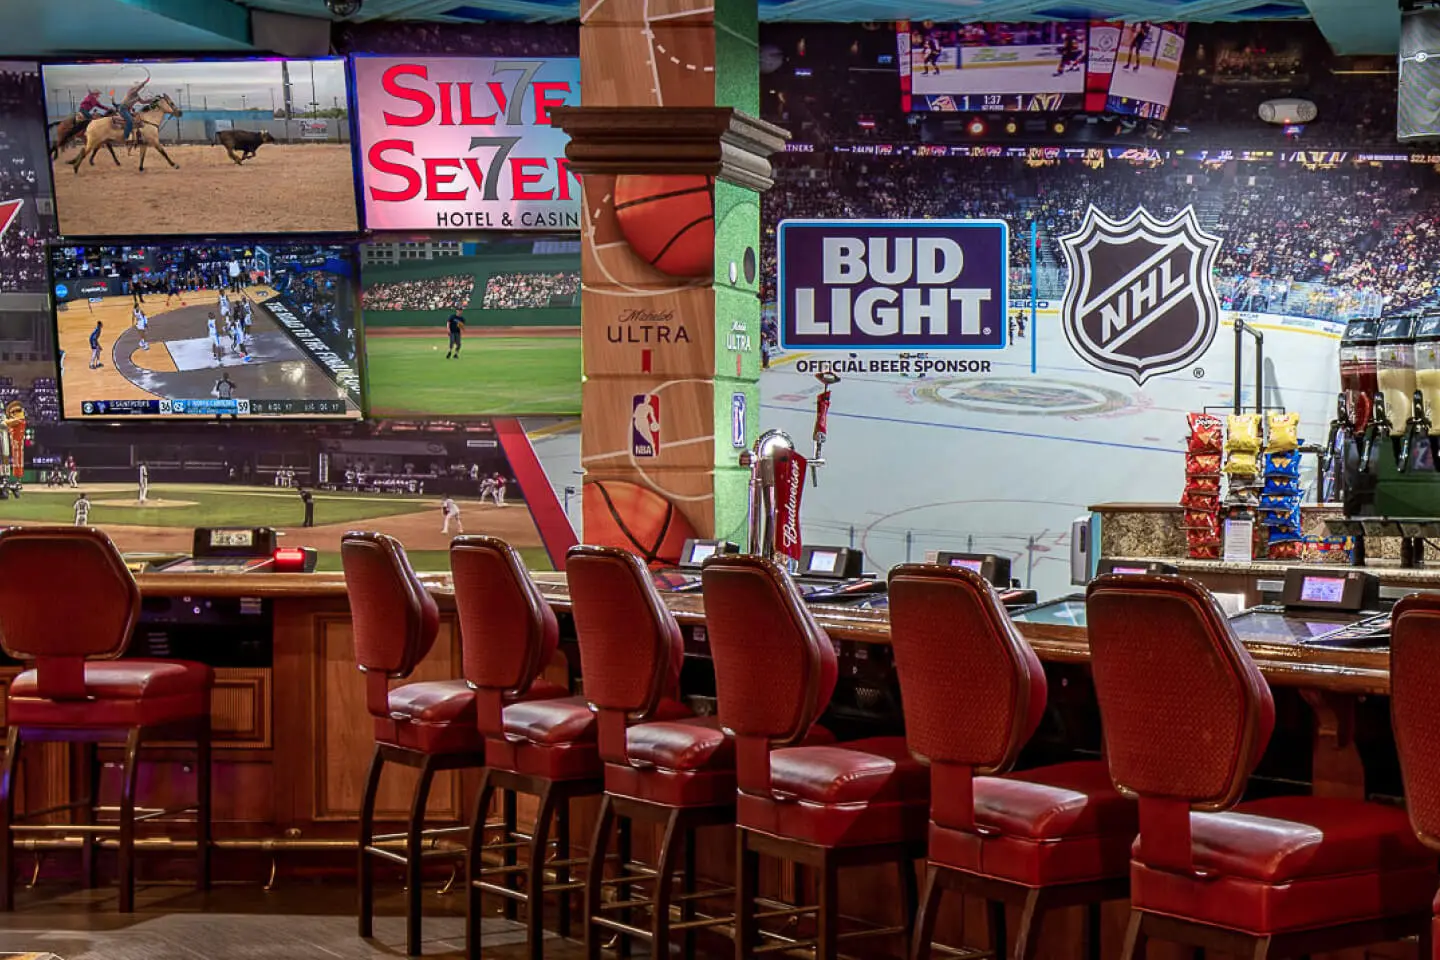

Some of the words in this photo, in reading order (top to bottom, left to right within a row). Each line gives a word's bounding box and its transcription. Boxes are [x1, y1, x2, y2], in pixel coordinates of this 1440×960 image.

[381, 60, 581, 127] SILVE
[437, 212, 493, 226] HOTEL
[501, 212, 513, 226] &
[521, 212, 579, 226] CASIN
[823, 237, 964, 285] BUD
[1100, 258, 1185, 344] NHL
[618, 308, 674, 323] Michelob
[795, 286, 992, 337] LIGHT
[607, 325, 690, 344] ULTRA
[726, 333, 752, 352] ULTRA
[796, 360, 868, 374] OFFICIAL
[870, 360, 910, 374] BEER
[915, 360, 991, 374] SPONSOR
[160, 401, 172, 413] 36
[238, 401, 249, 413] 59
[635, 445, 652, 455] NBA
[782, 459, 800, 549] Budweiser
